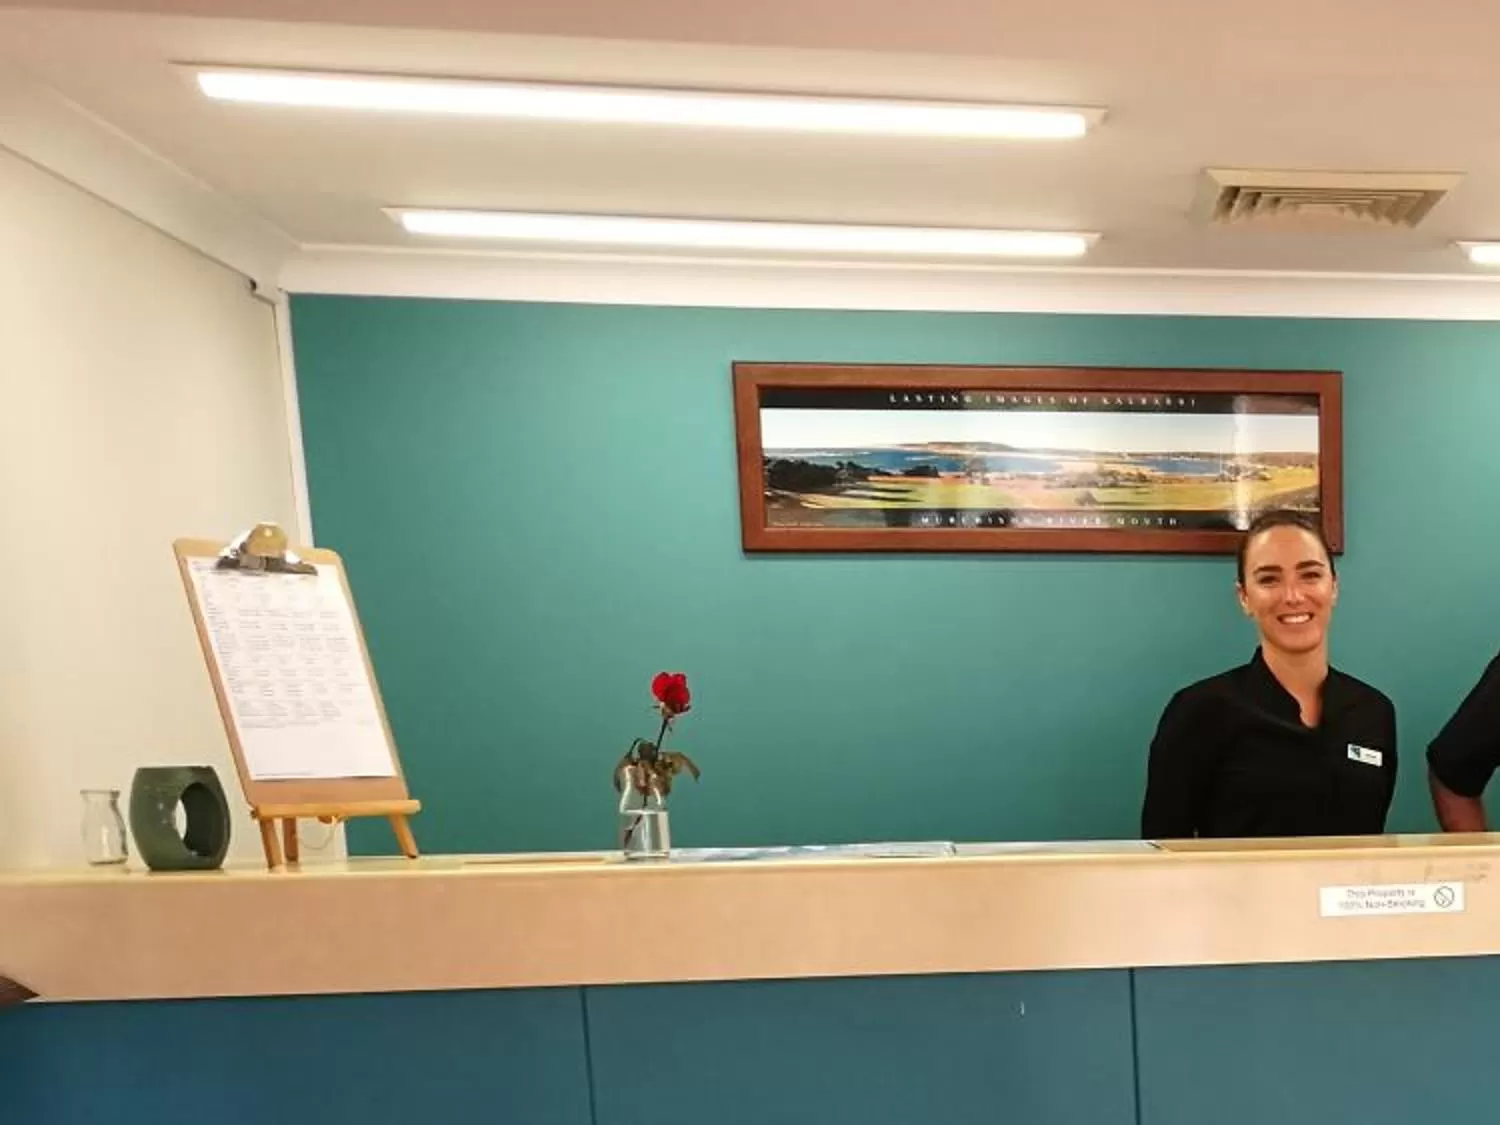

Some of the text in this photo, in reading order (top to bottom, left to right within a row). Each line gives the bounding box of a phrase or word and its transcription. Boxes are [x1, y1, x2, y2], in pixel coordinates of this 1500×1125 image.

[889, 393, 973, 404] LASTING
[985, 394, 1056, 405] IMAGES
[1116, 516, 1178, 527] MOUTH
